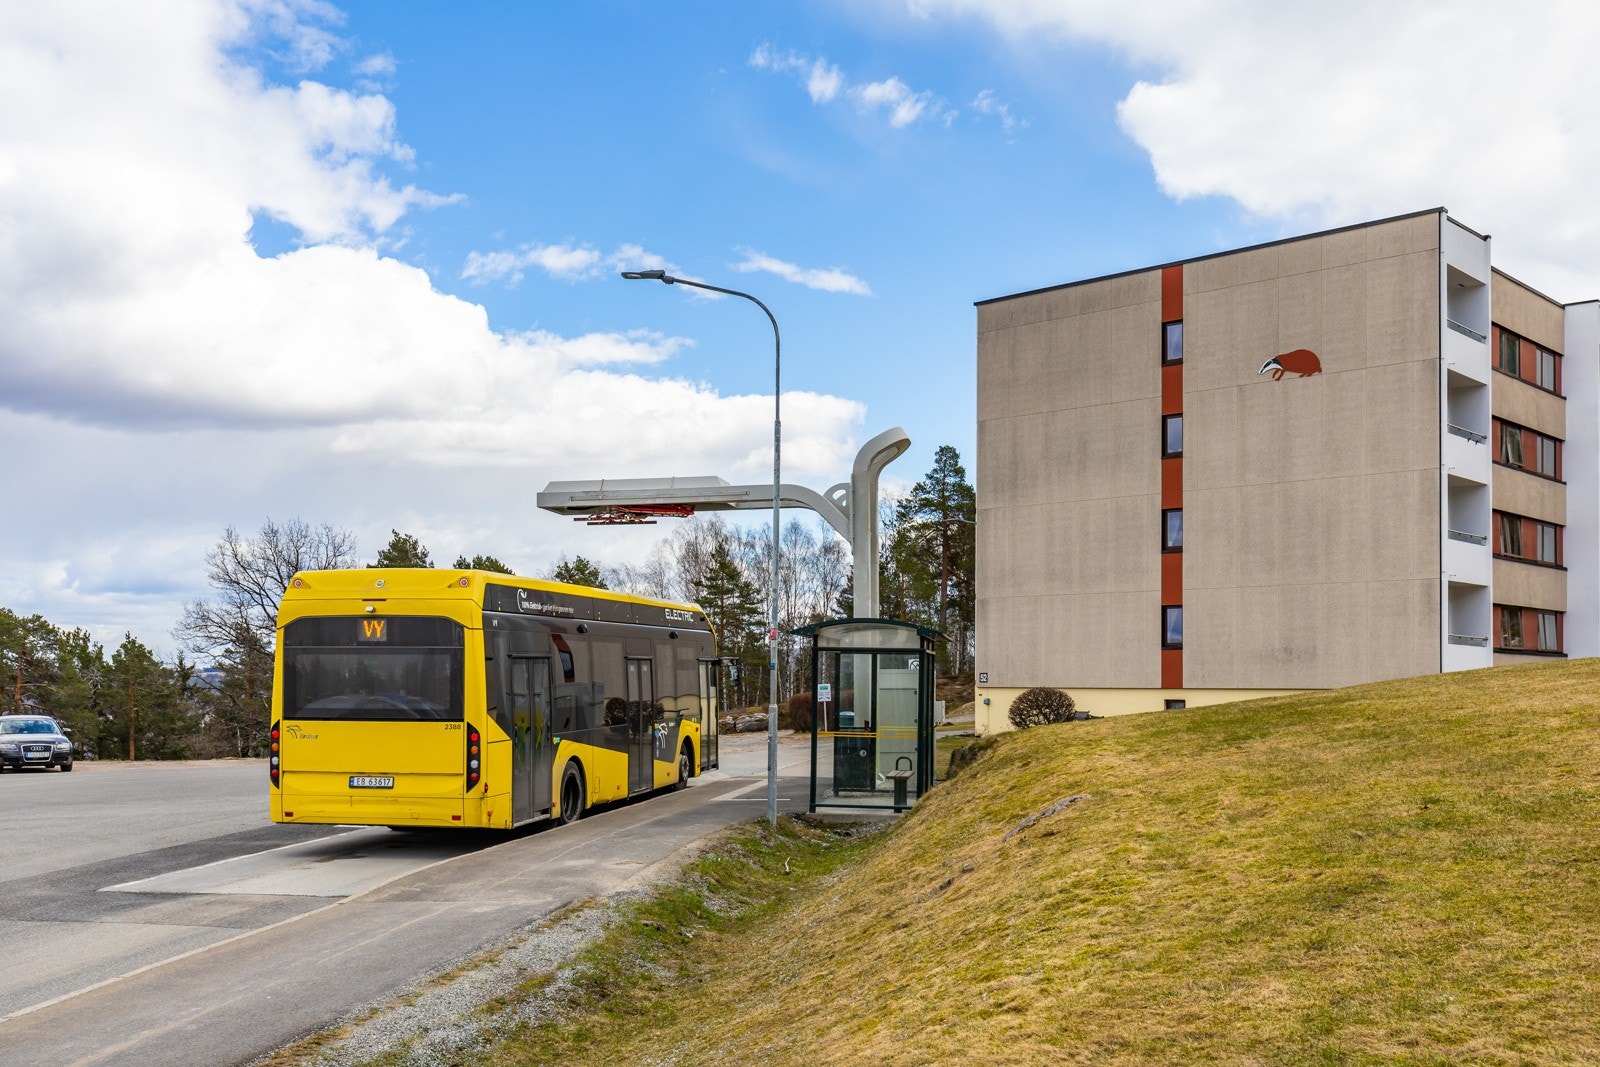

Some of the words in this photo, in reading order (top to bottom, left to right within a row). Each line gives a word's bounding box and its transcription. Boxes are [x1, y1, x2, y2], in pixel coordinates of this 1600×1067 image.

[665, 608, 694, 622] ELECTRIC
[363, 620, 384, 638] VY
[980, 673, 988, 682] 52
[368, 778, 390, 786] 63617
